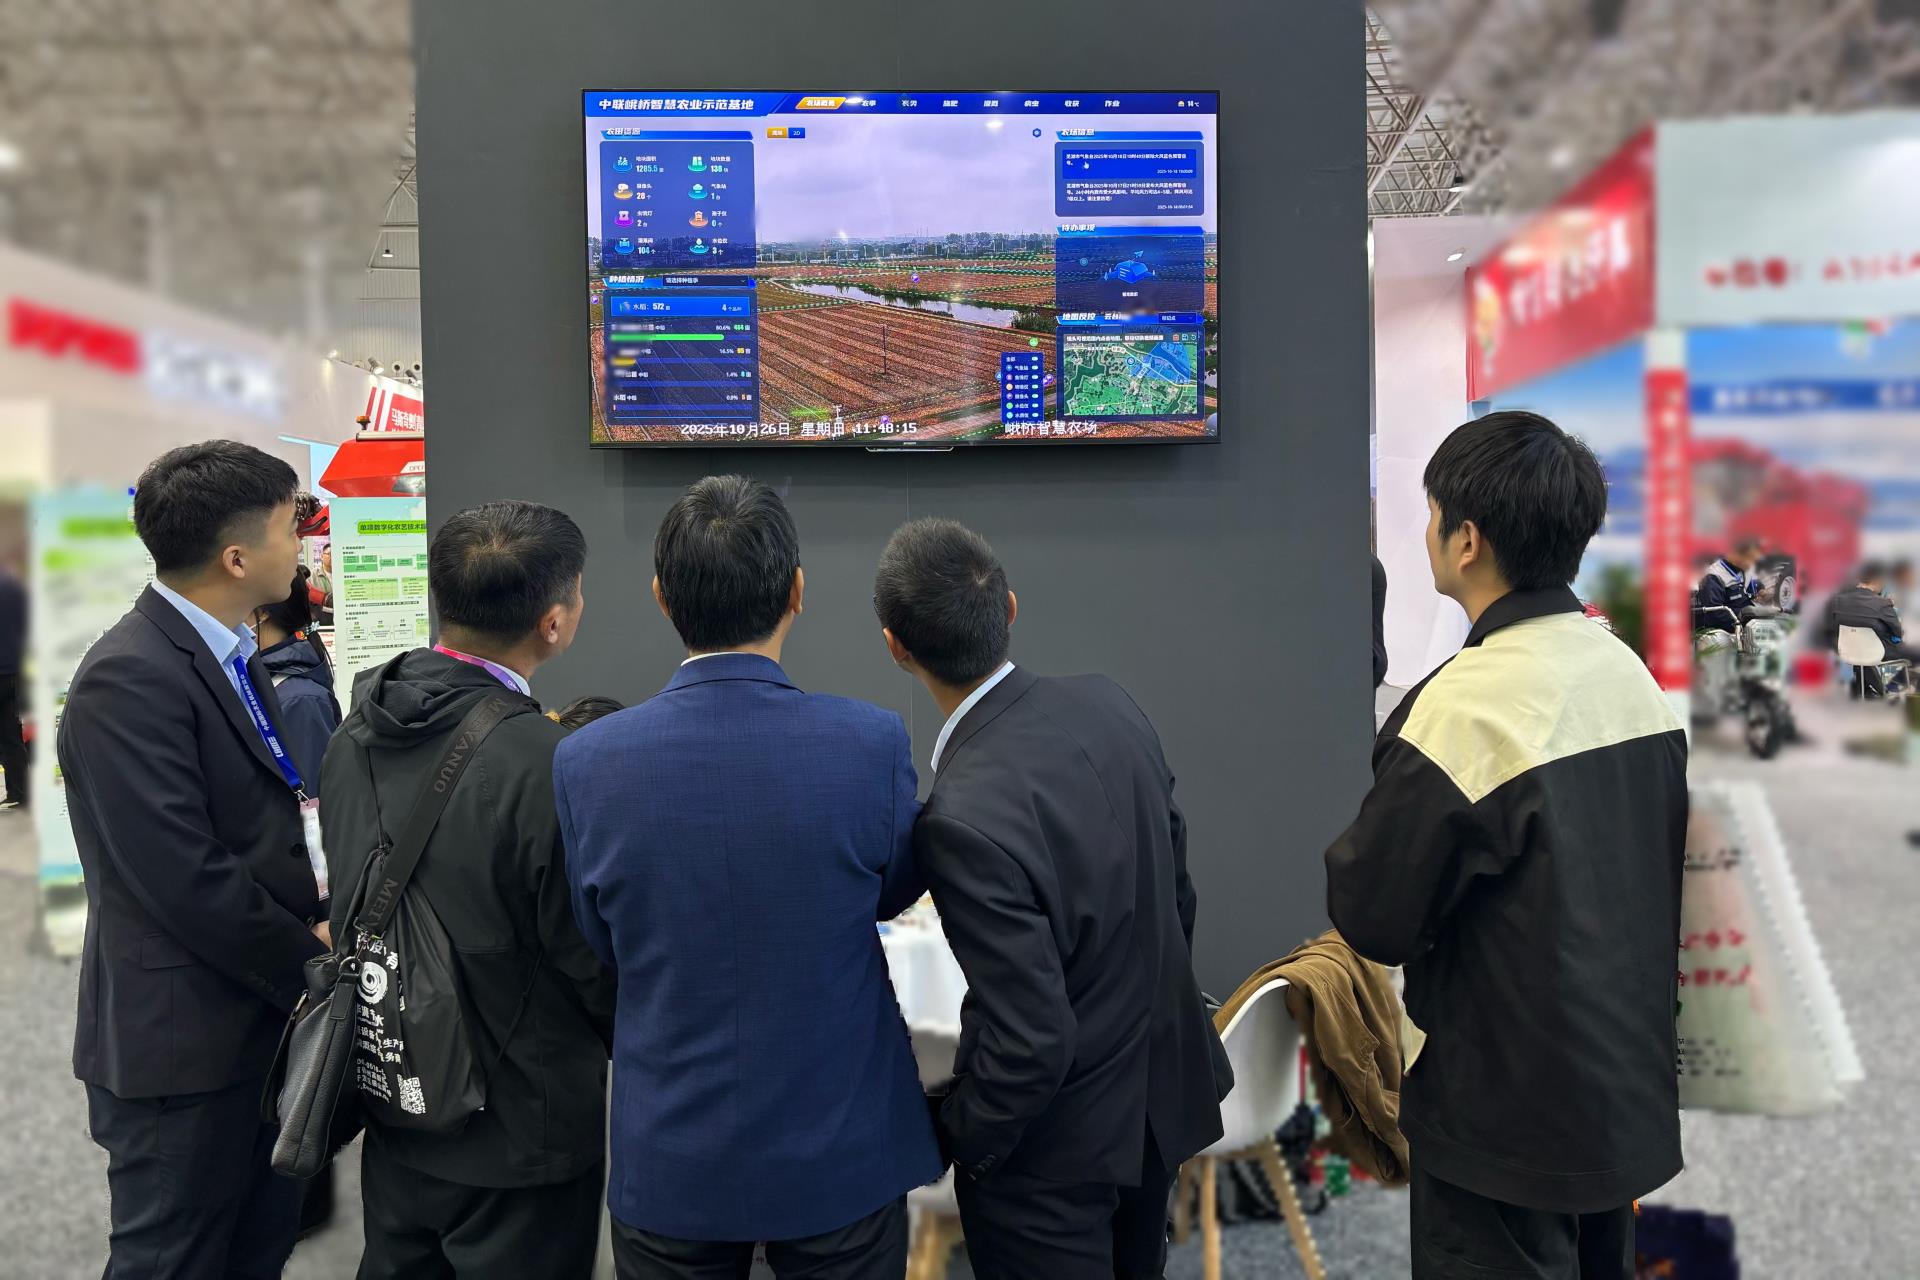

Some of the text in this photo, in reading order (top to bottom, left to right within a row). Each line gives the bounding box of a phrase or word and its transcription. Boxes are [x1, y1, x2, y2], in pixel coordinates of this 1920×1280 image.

[599, 99, 754, 110] 中联峨桥智慧农业示范基地
[1104, 100, 1120, 108] 作业
[606, 128, 641, 136] 农田资源
[1062, 224, 1096, 232] 待办事项
[680, 422, 790, 438] 2025年10月26日
[854, 422, 917, 434] 11:48:15
[1004, 420, 1098, 436] 峨桥智慧农场
